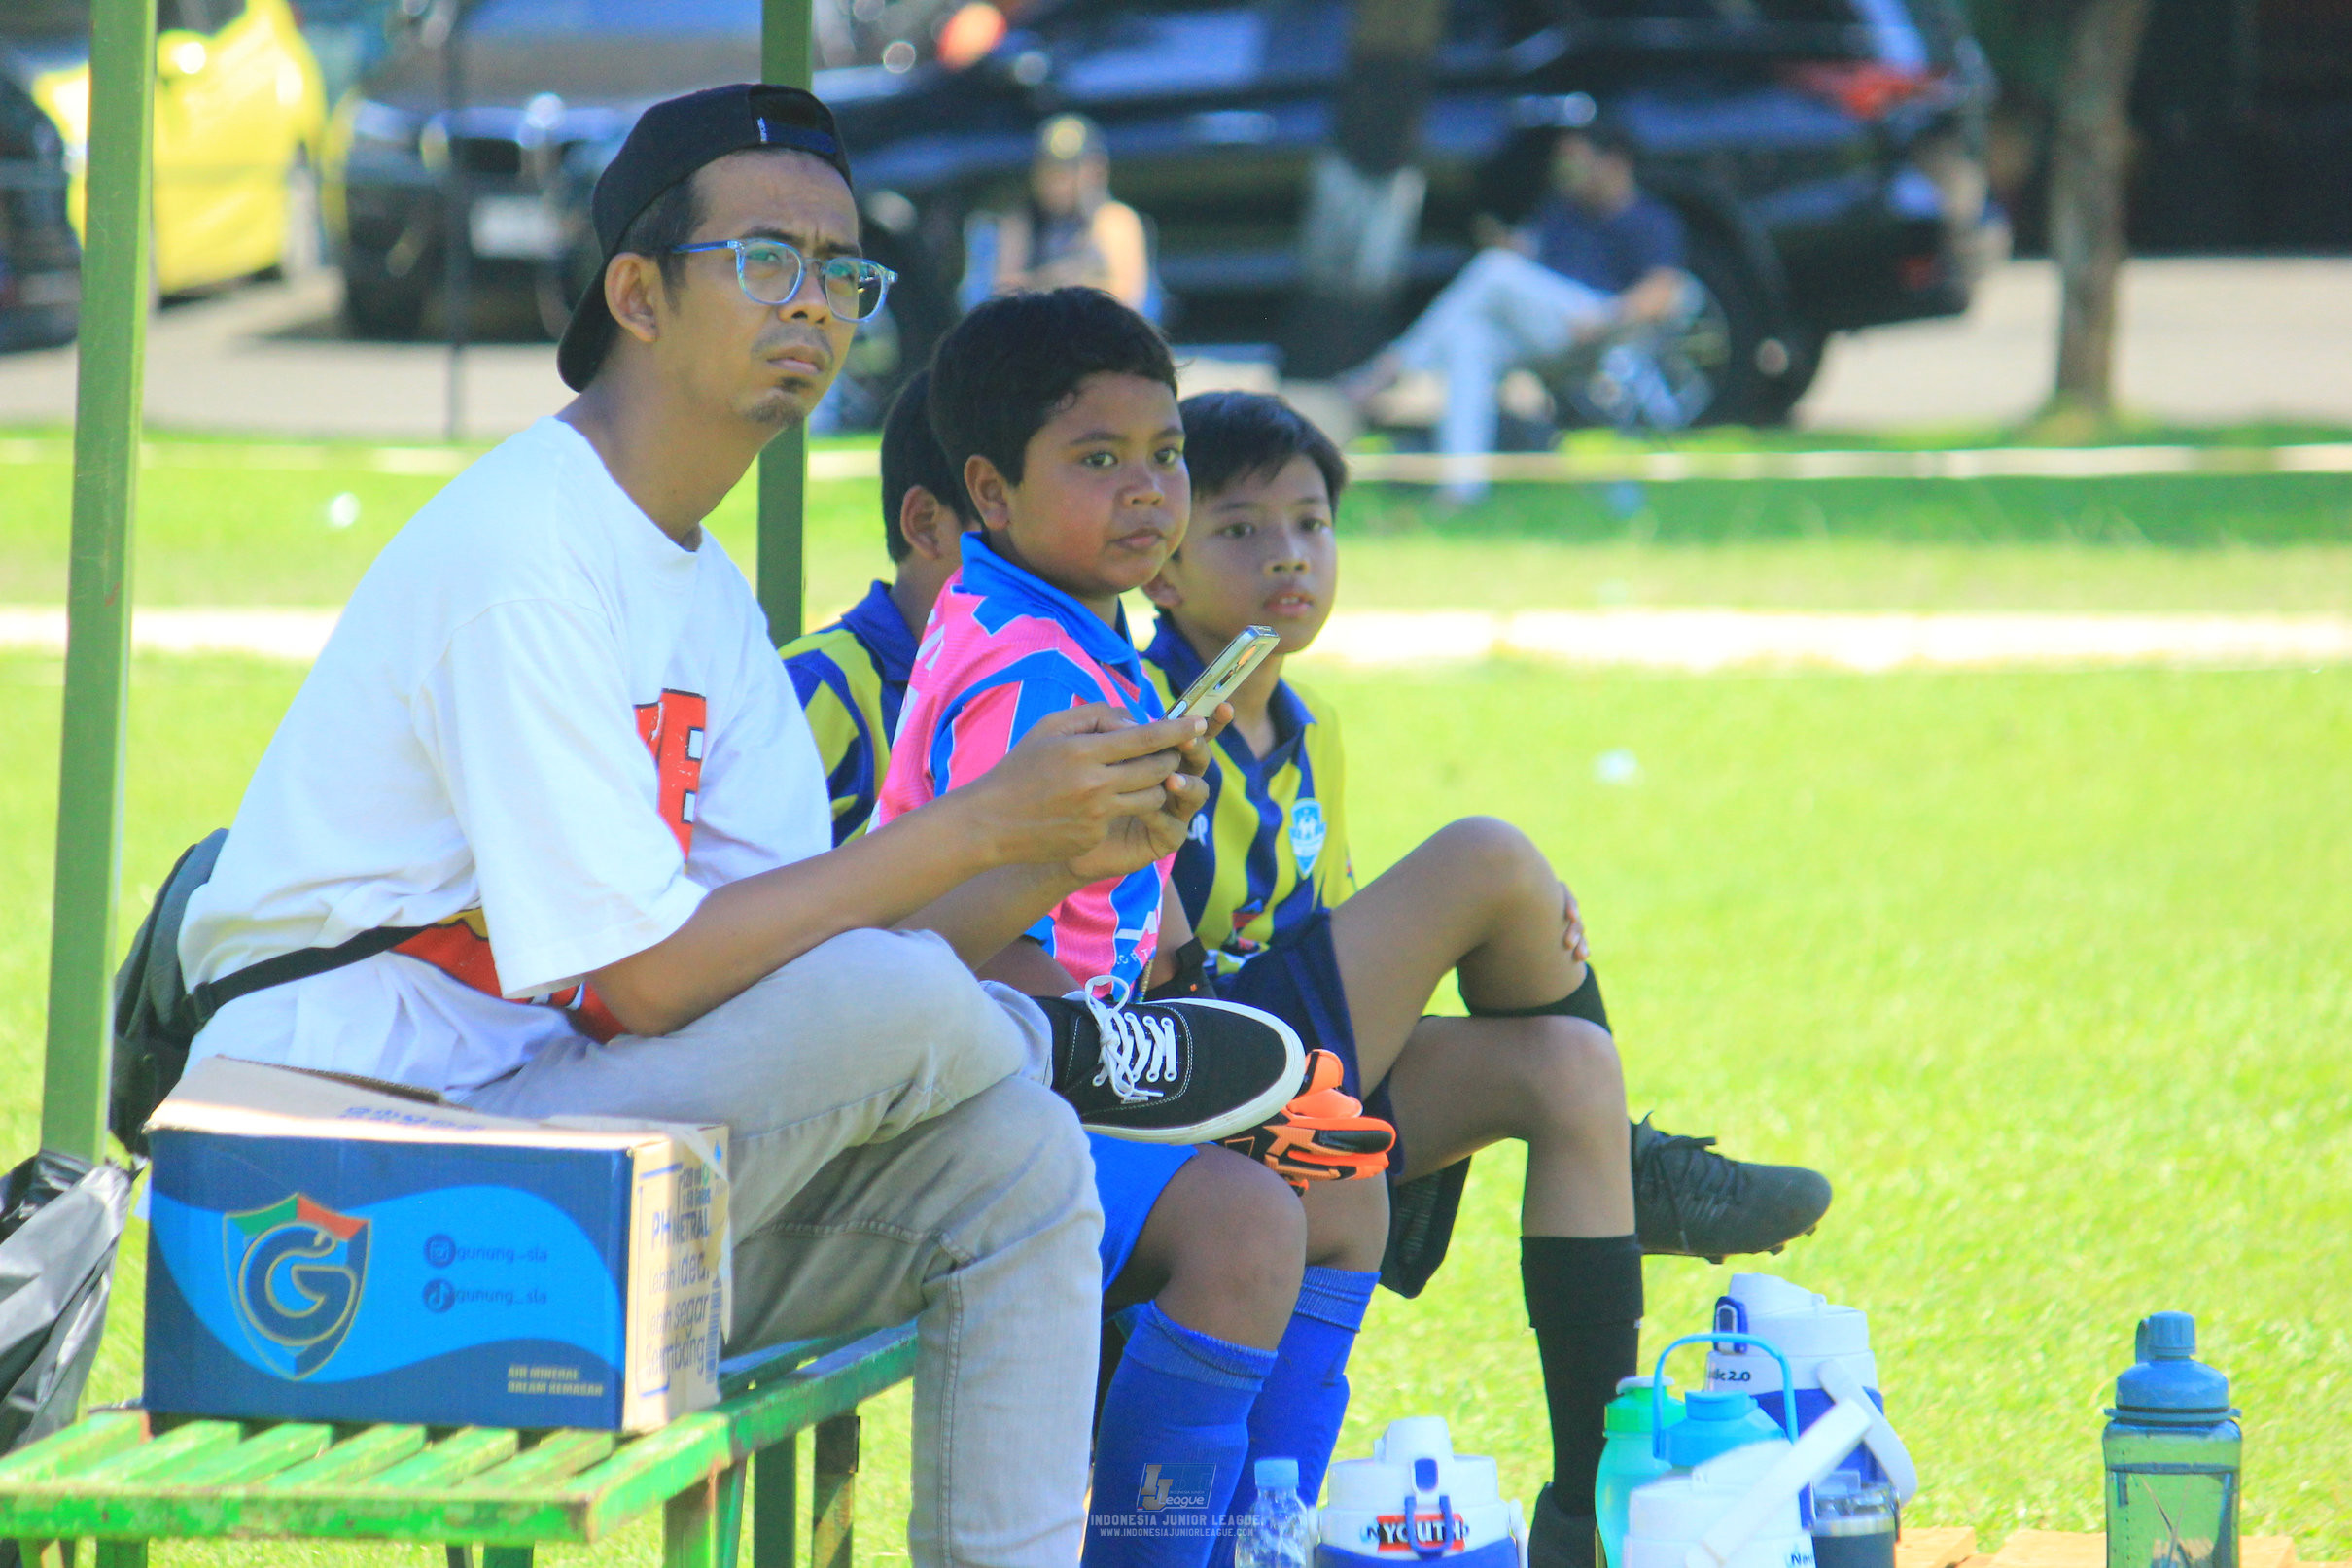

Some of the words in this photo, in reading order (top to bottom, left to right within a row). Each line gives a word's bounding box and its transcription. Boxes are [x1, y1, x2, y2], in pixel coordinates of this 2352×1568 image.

[649, 1266, 675, 1295] Lebih
[646, 1306, 672, 1338] Lebih
[674, 1295, 709, 1339] segar
[645, 1337, 705, 1377] Seimbang
[1728, 1370, 1751, 1381] 2.0
